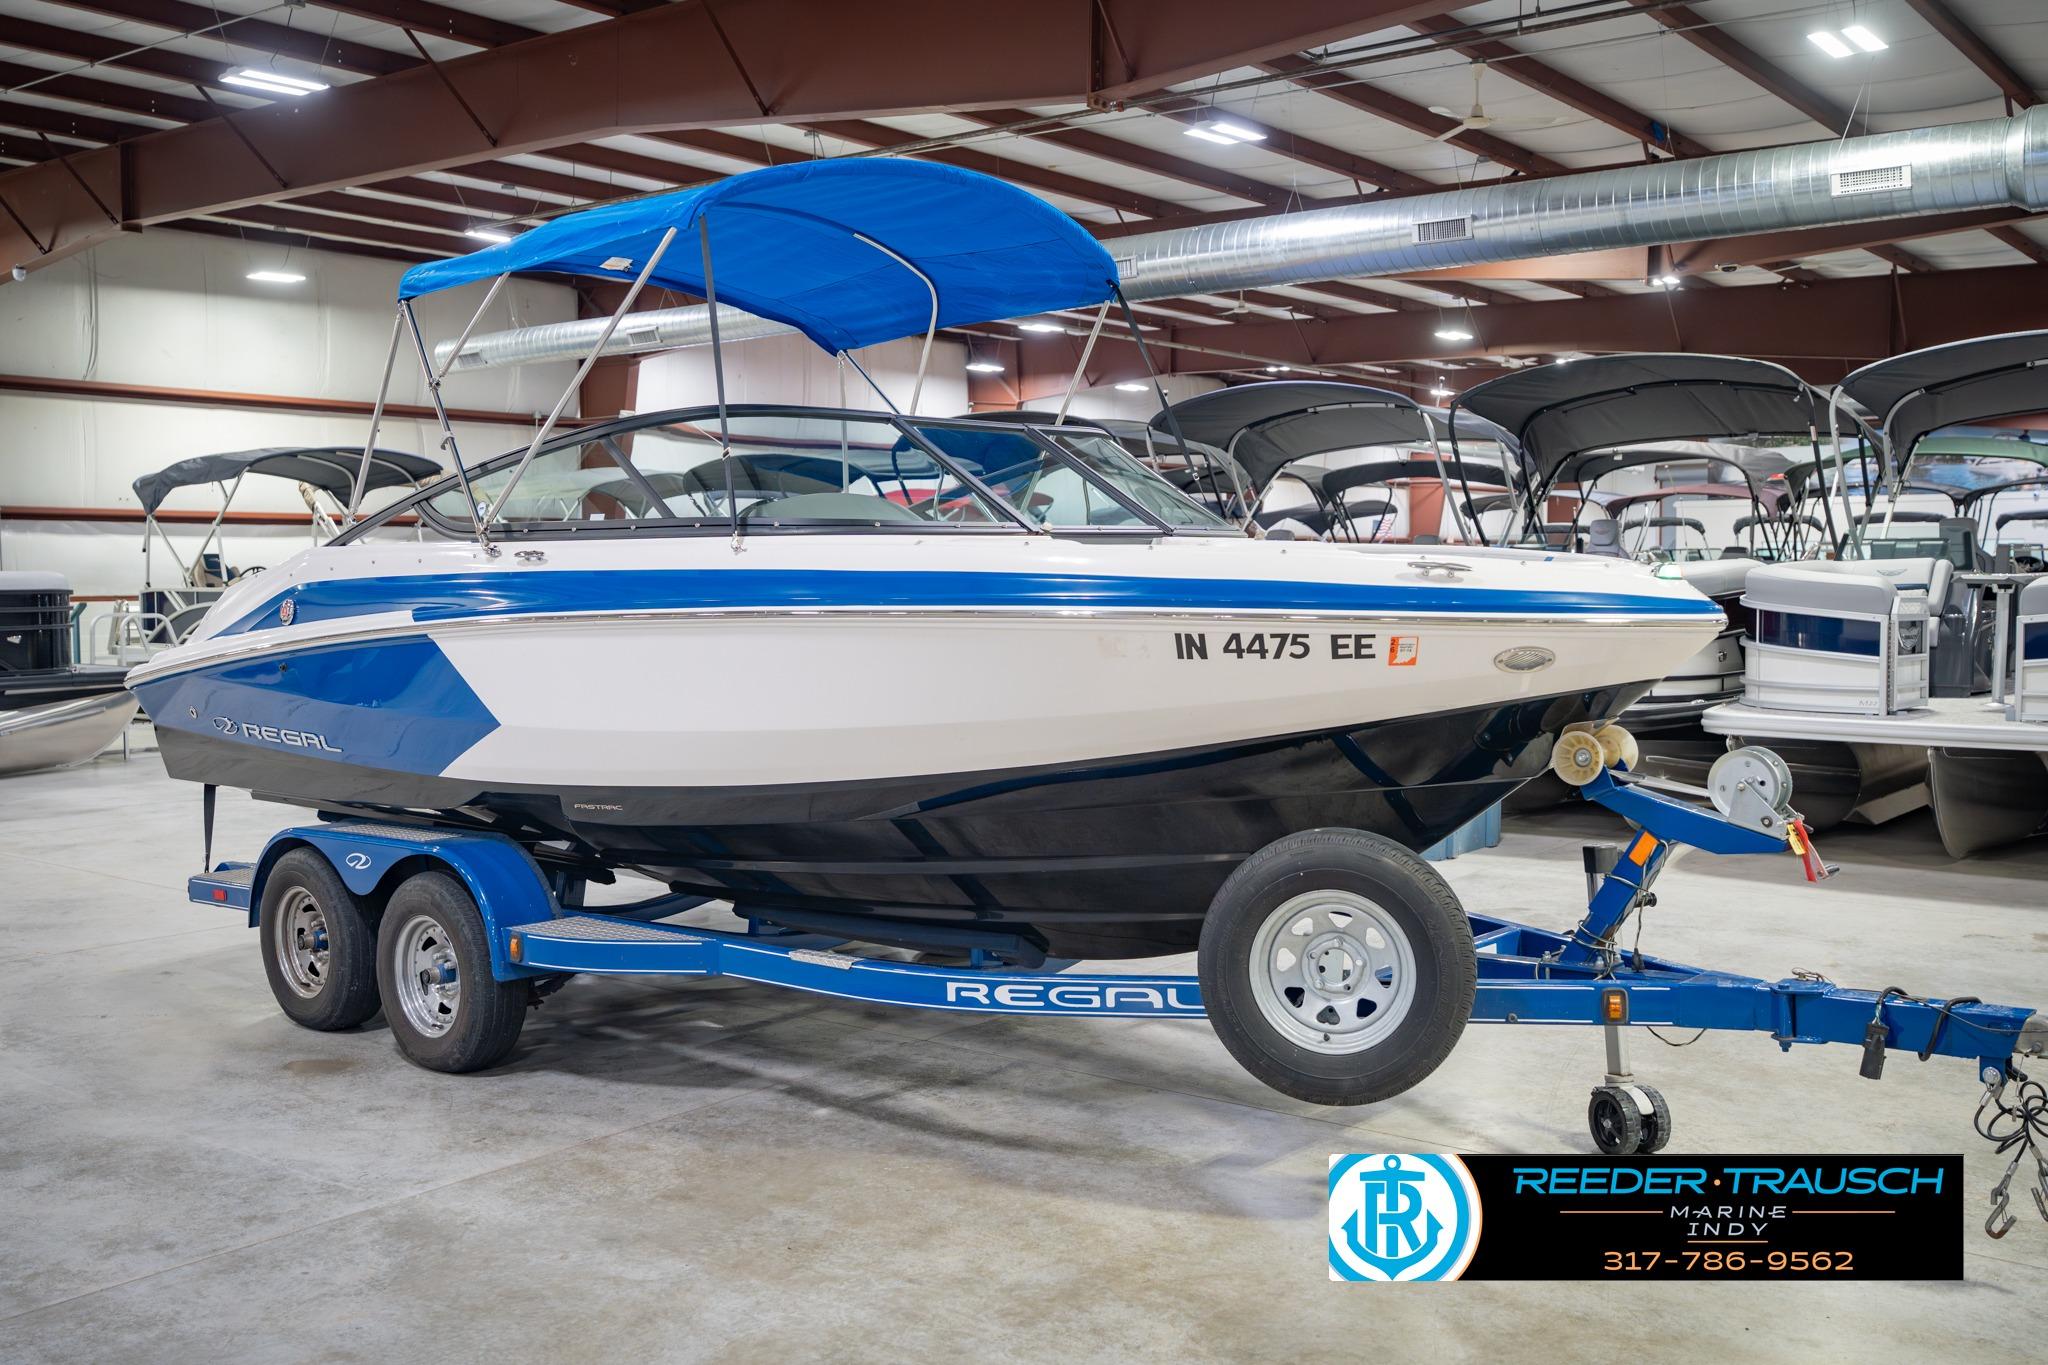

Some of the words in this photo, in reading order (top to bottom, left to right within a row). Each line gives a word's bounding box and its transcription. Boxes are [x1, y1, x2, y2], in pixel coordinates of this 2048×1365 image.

[1174, 633, 1208, 660] IN
[1223, 633, 1310, 660] 4475
[1330, 634, 1376, 660] EE
[241, 722, 344, 753] REGAL
[946, 981, 1206, 1009] REGAL
